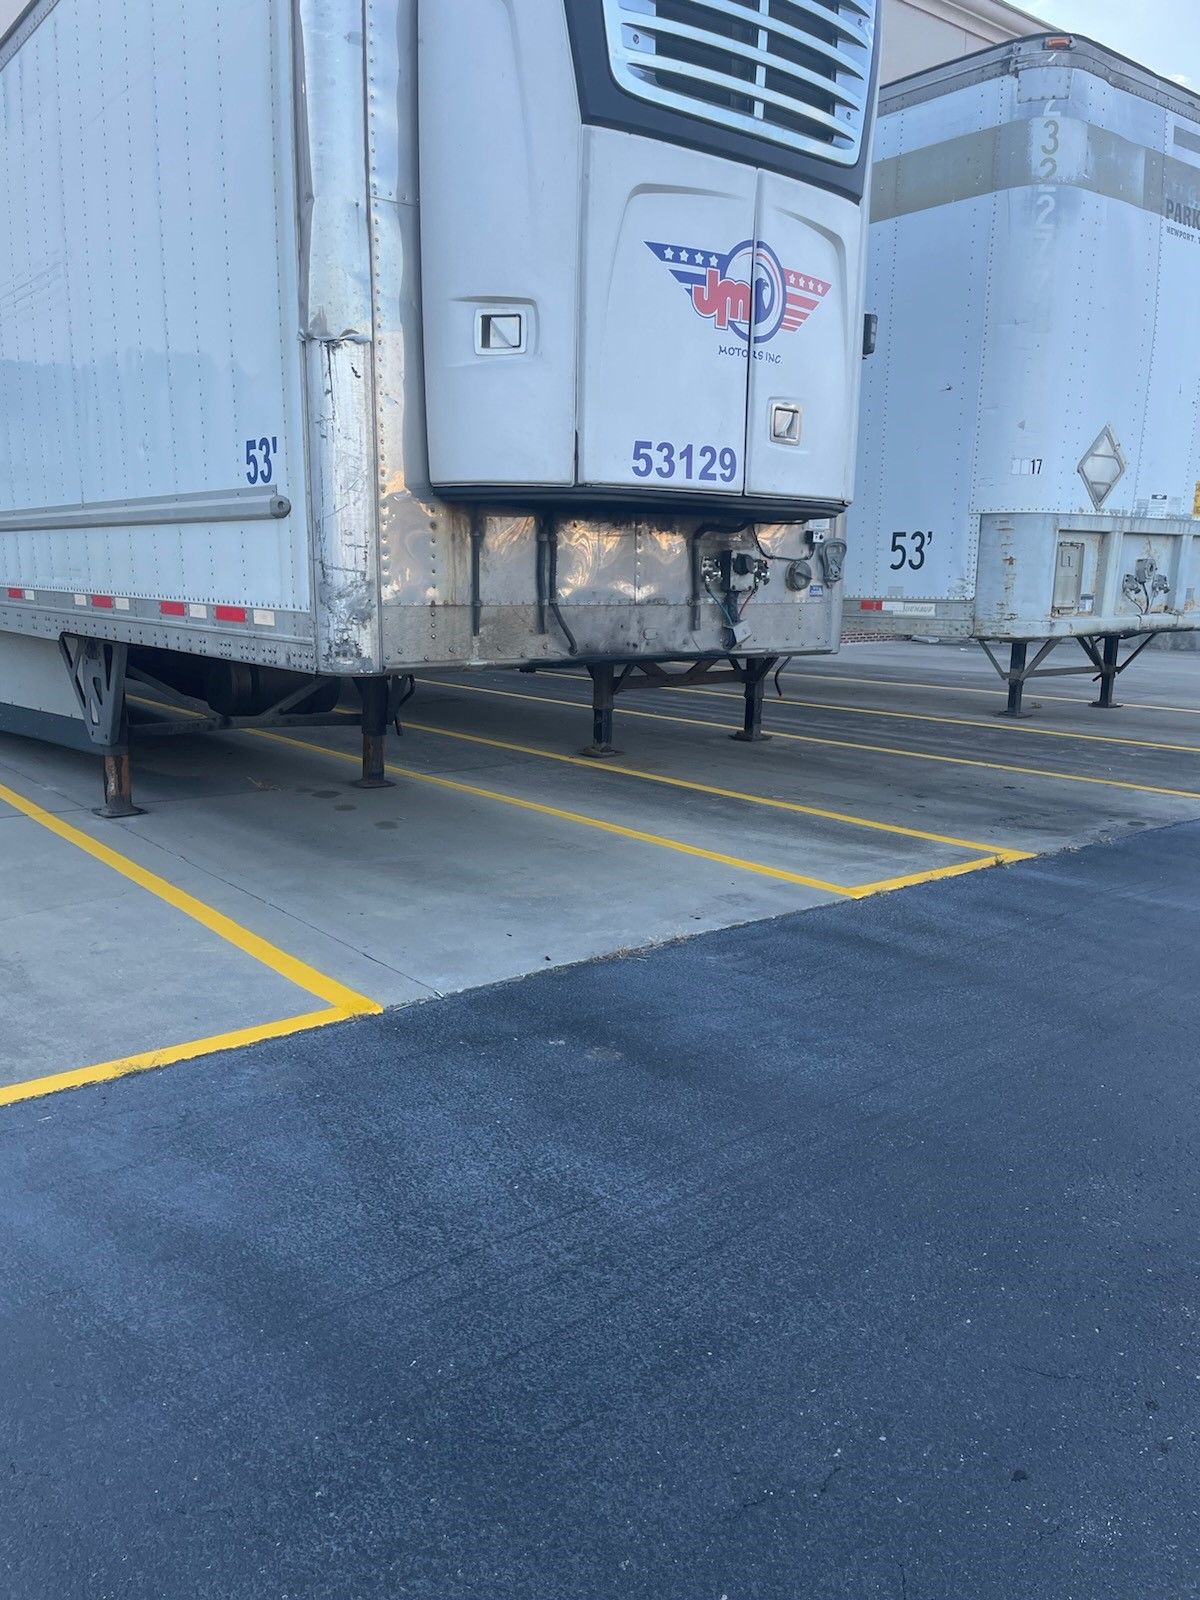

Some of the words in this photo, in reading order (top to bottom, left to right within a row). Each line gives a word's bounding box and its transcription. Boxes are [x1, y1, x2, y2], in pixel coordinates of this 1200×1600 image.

[246, 436, 277, 485] 53'
[631, 440, 737, 483] 53129
[1031, 458, 1043, 475] 17
